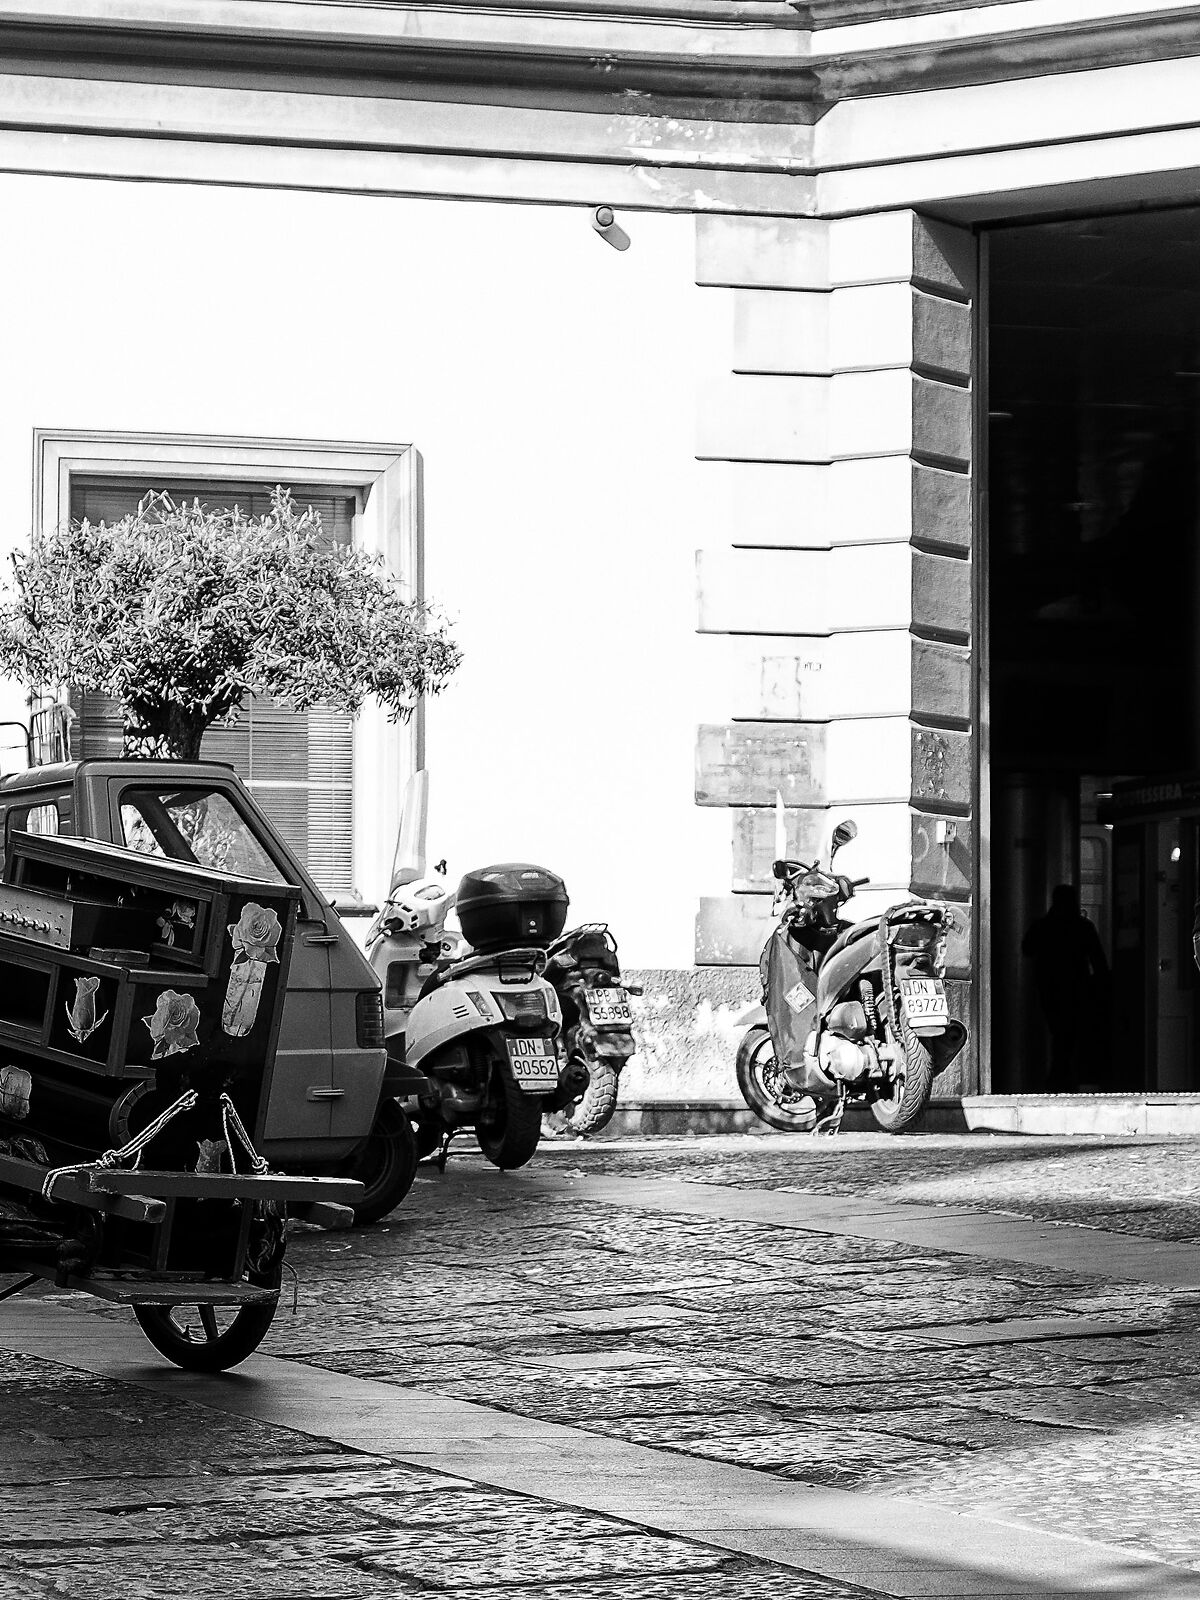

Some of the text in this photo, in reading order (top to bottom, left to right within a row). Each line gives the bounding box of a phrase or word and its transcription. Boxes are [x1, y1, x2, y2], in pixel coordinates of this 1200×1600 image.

[912, 980, 929, 994] DN
[907, 997, 944, 1013] 89727
[518, 1039, 537, 1055] DN
[513, 1059, 557, 1075] 90562
